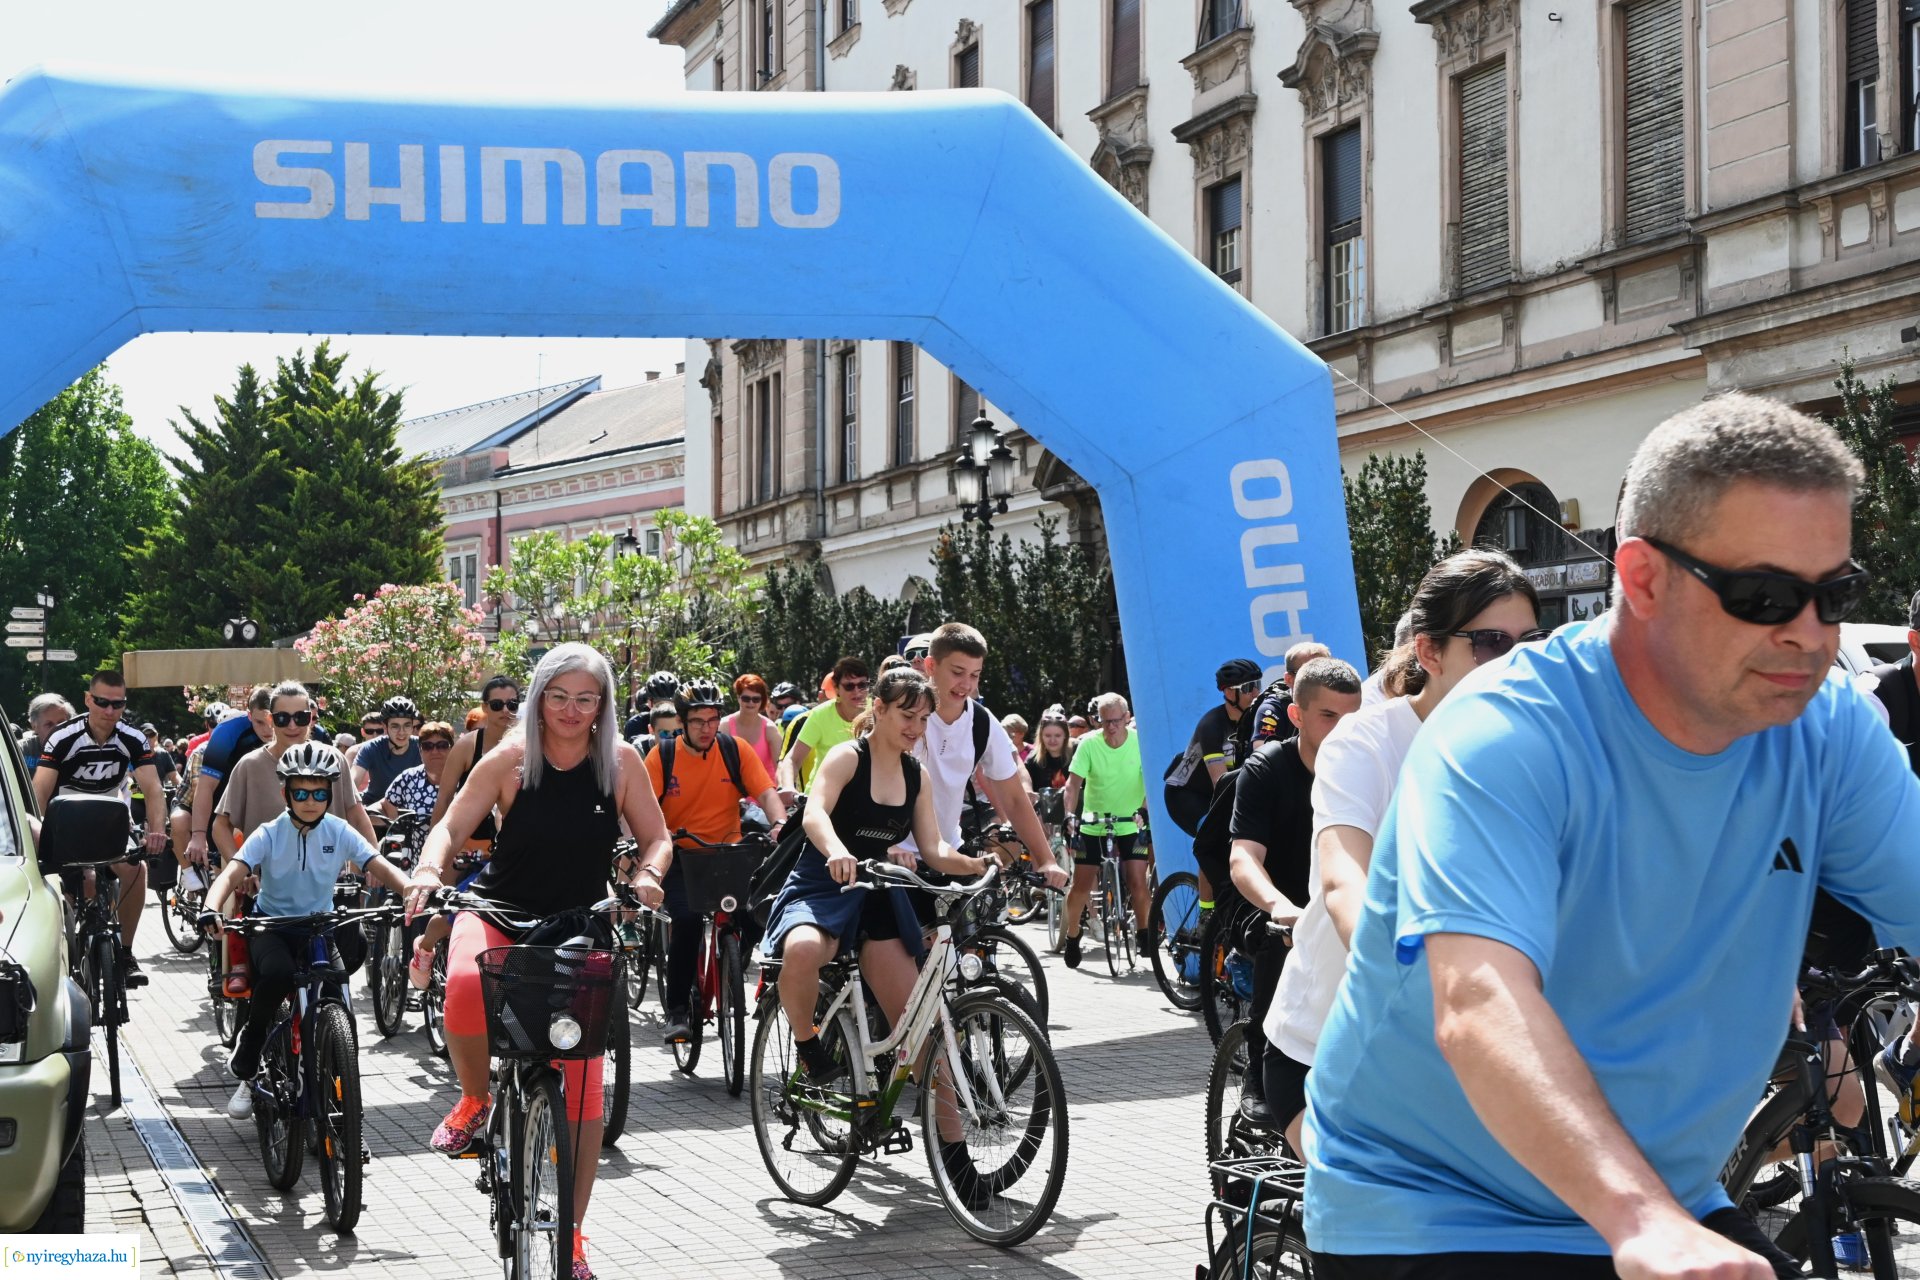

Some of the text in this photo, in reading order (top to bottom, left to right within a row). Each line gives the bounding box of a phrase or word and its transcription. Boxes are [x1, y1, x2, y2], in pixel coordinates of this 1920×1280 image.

[252, 139, 841, 229] SHIMANO
[1229, 458, 1314, 690] ANO
[72, 761, 120, 781] KTM
